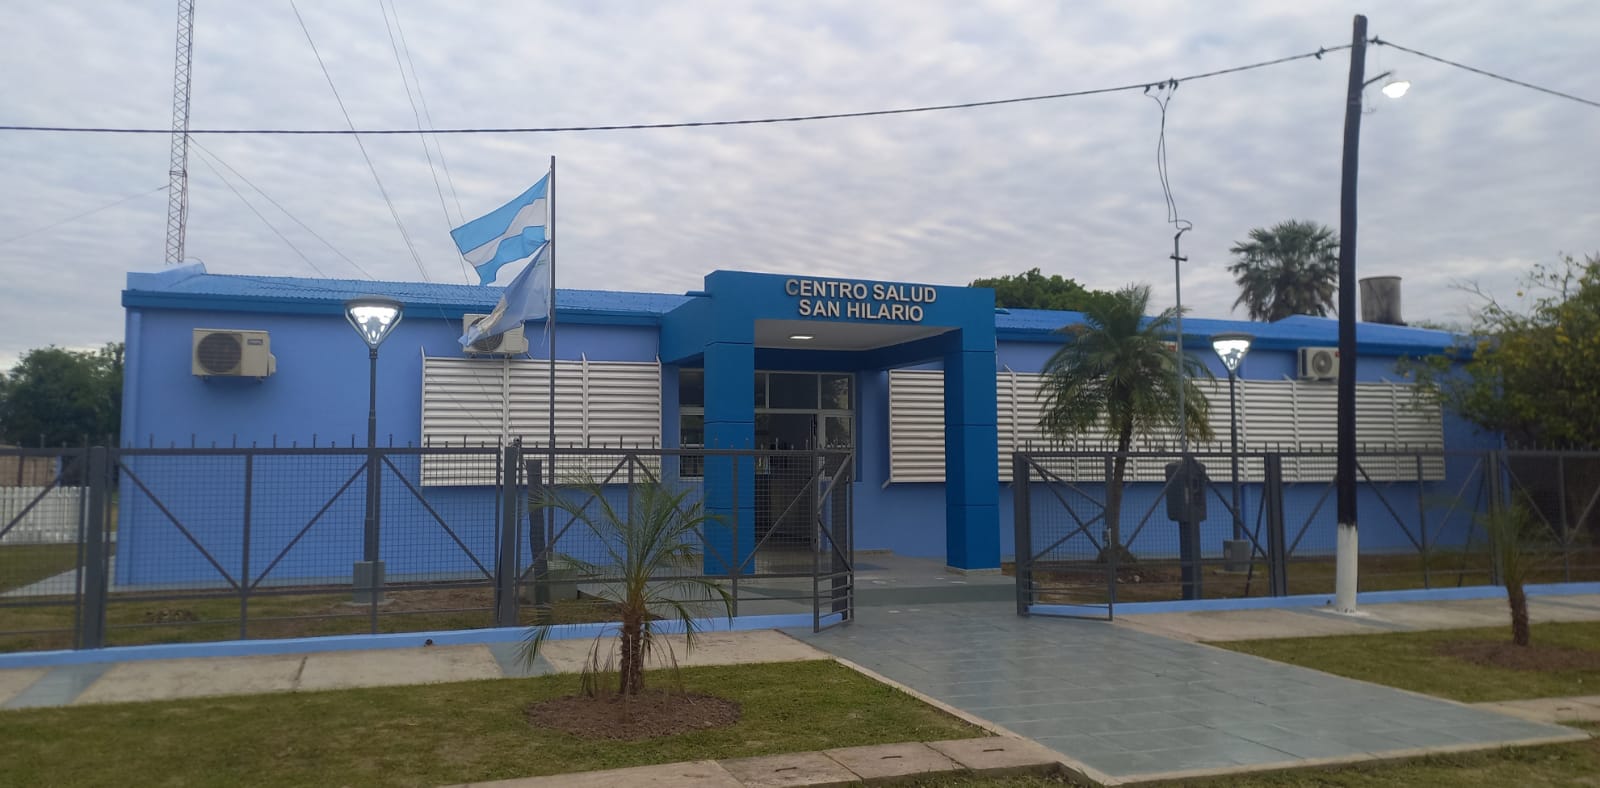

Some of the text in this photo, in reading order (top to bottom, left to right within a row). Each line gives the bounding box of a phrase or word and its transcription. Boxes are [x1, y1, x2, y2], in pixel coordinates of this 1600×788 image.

[785, 278, 937, 303] CENTRO SALUD
[799, 299, 924, 321] SAN HILARIO
